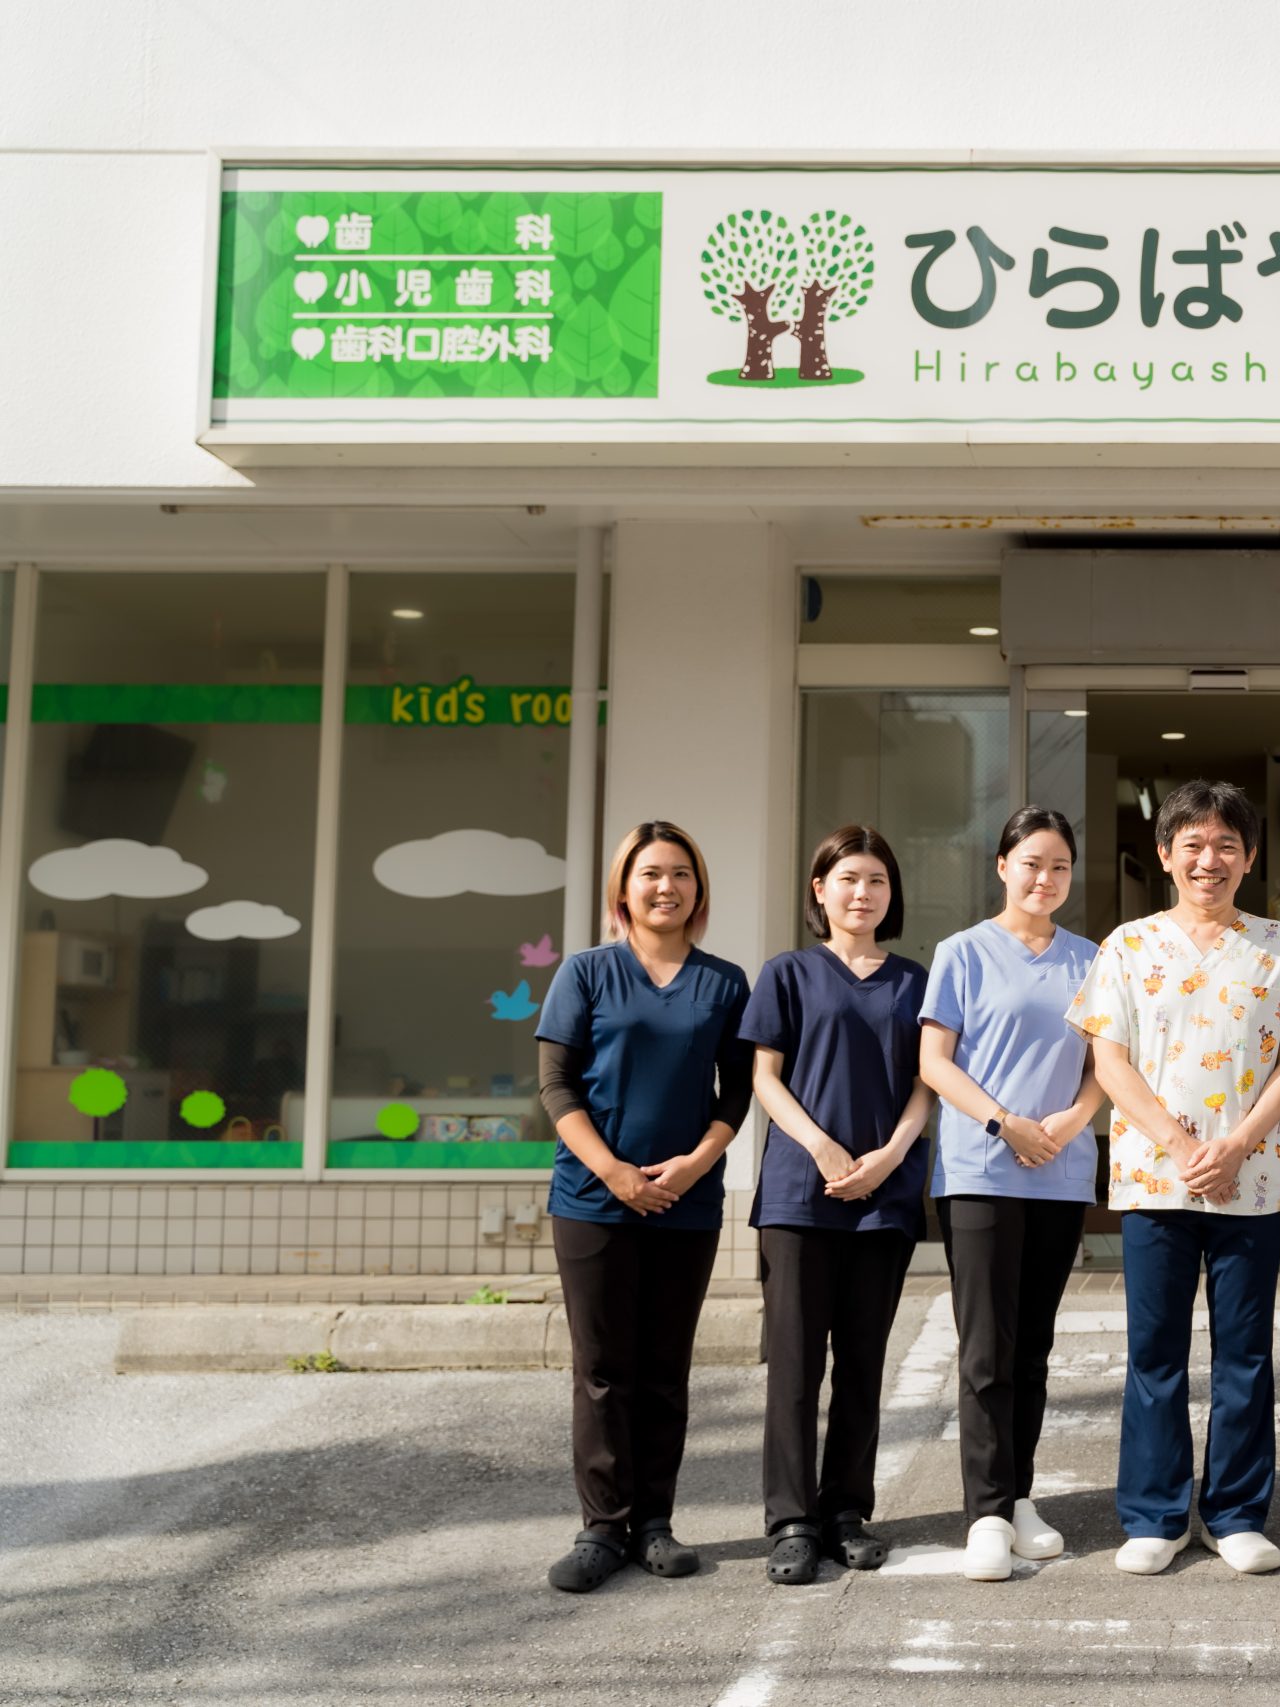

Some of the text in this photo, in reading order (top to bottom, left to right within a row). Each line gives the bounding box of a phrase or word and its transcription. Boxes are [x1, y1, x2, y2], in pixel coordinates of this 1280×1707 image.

[334, 268, 554, 307] 小児歯科
[330, 324, 553, 364] 歯科口腔外科
[391, 679, 573, 723] kid's roo
